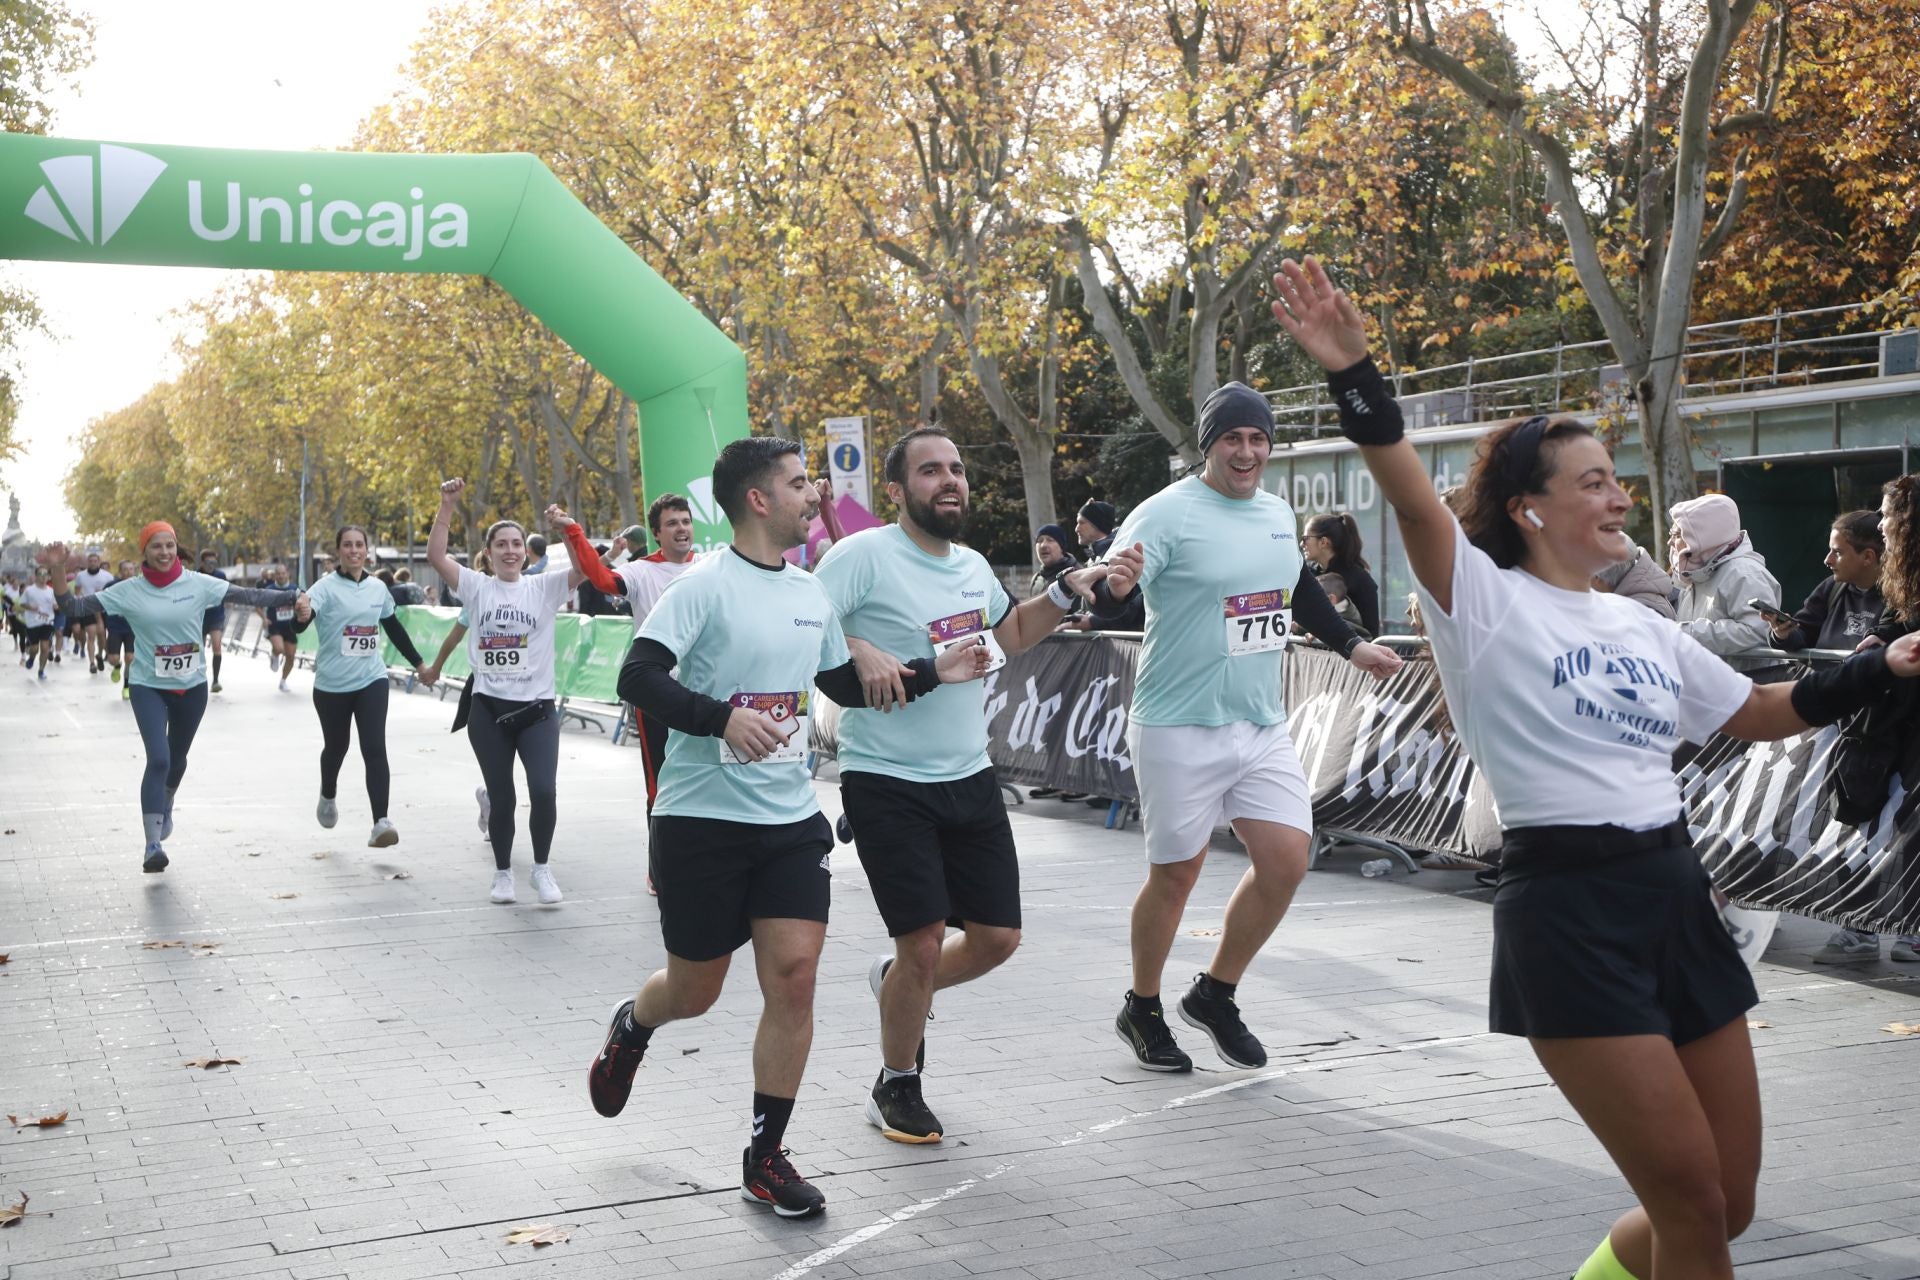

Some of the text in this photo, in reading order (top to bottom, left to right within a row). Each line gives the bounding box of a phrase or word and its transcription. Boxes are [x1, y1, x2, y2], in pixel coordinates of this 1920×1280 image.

[188, 180, 469, 261] Unicaja
[1237, 613, 1286, 642] 776
[349, 637, 376, 650] 798
[162, 655, 192, 671] 797
[484, 650, 520, 666] 869
[1552, 646, 1591, 689] RIO
[740, 695, 753, 708] 9ª
